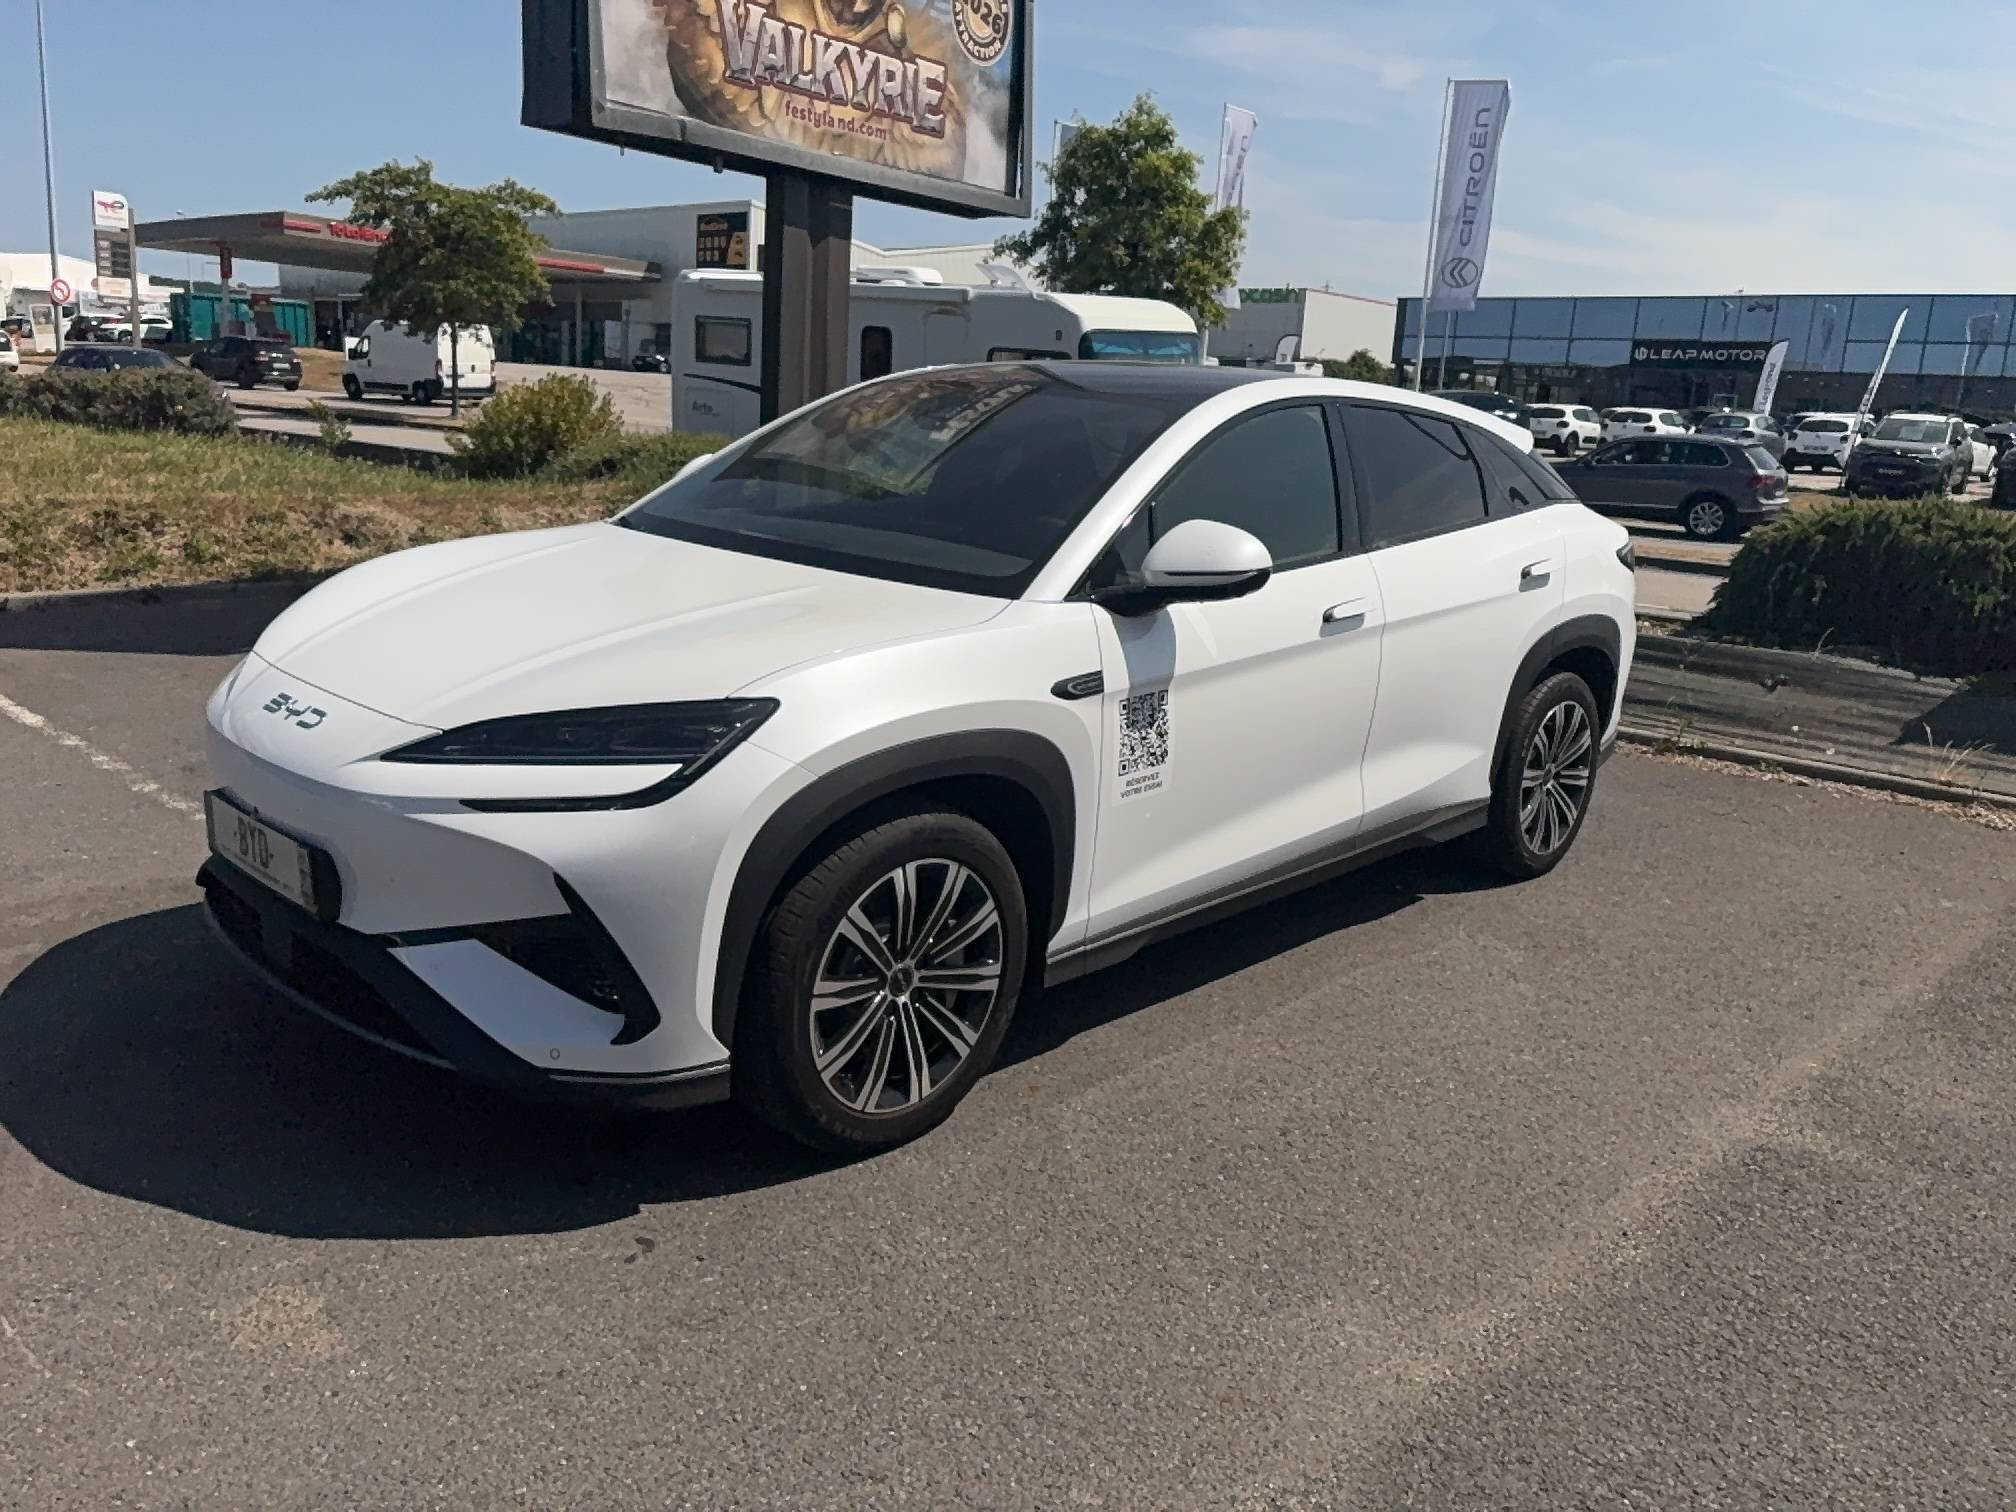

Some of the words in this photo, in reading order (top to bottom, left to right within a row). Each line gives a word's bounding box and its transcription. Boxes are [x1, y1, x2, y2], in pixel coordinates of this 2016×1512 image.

[963, 0, 1002, 34] 026
[719, 0, 947, 137] VALKYRIE
[785, 101, 887, 140] festyland.com
[1459, 107, 1492, 247] CITROËN
[262, 692, 327, 729] BYD
